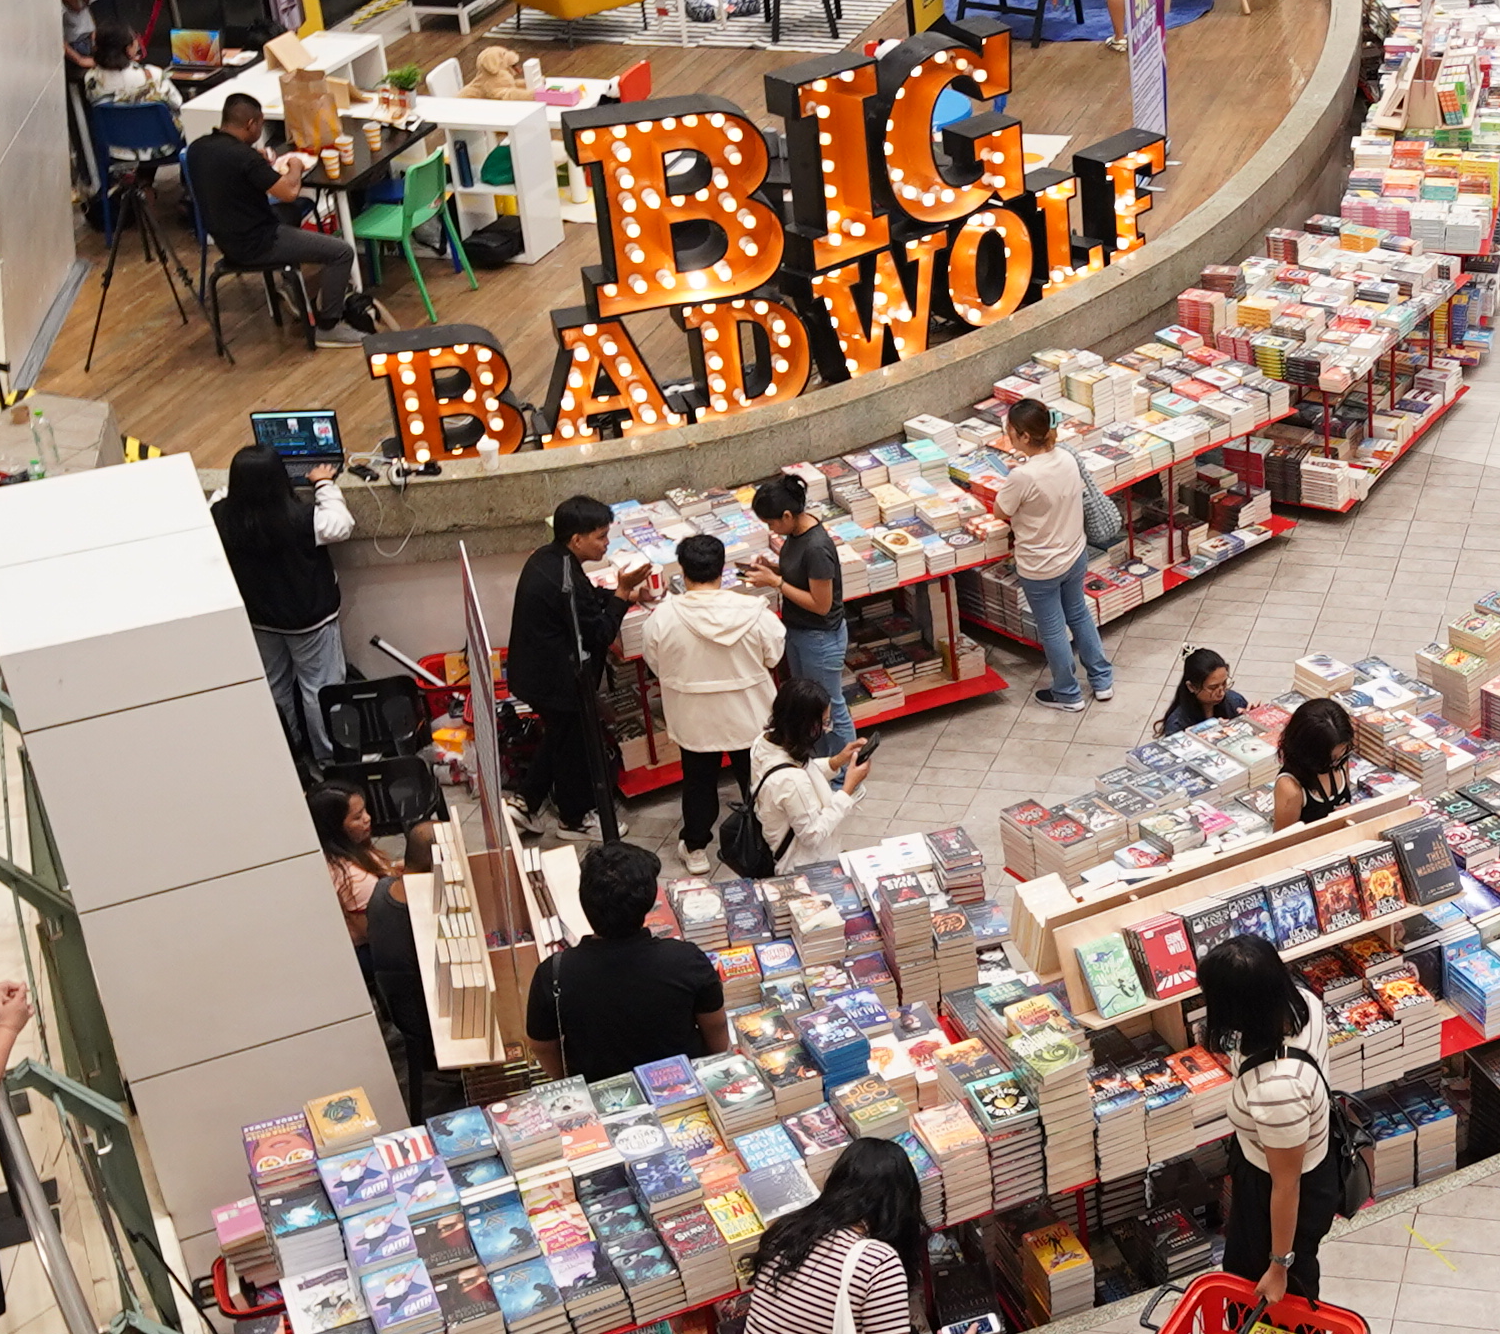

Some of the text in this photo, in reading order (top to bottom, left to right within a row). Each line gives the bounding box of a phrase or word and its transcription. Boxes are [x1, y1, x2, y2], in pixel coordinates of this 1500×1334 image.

[562, 17, 1026, 320] BIG
[364, 128, 1167, 464] BAD WOLF
[1358, 851, 1396, 870] KANE
[1312, 864, 1350, 885] KANE
[1270, 879, 1308, 900] KANE
[1164, 931, 1185, 948] GONE
[1167, 941, 1187, 954] WILD
[842, 1089, 888, 1108] TOO
[847, 1078, 879, 1099] DIG
[851, 1099, 901, 1120] DEEP
[361, 1179, 389, 1199] FAITH
[1145, 1208, 1184, 1227] PROJECT
[382, 1234, 410, 1257] FAITH
[404, 1295, 433, 1316] FAITH
